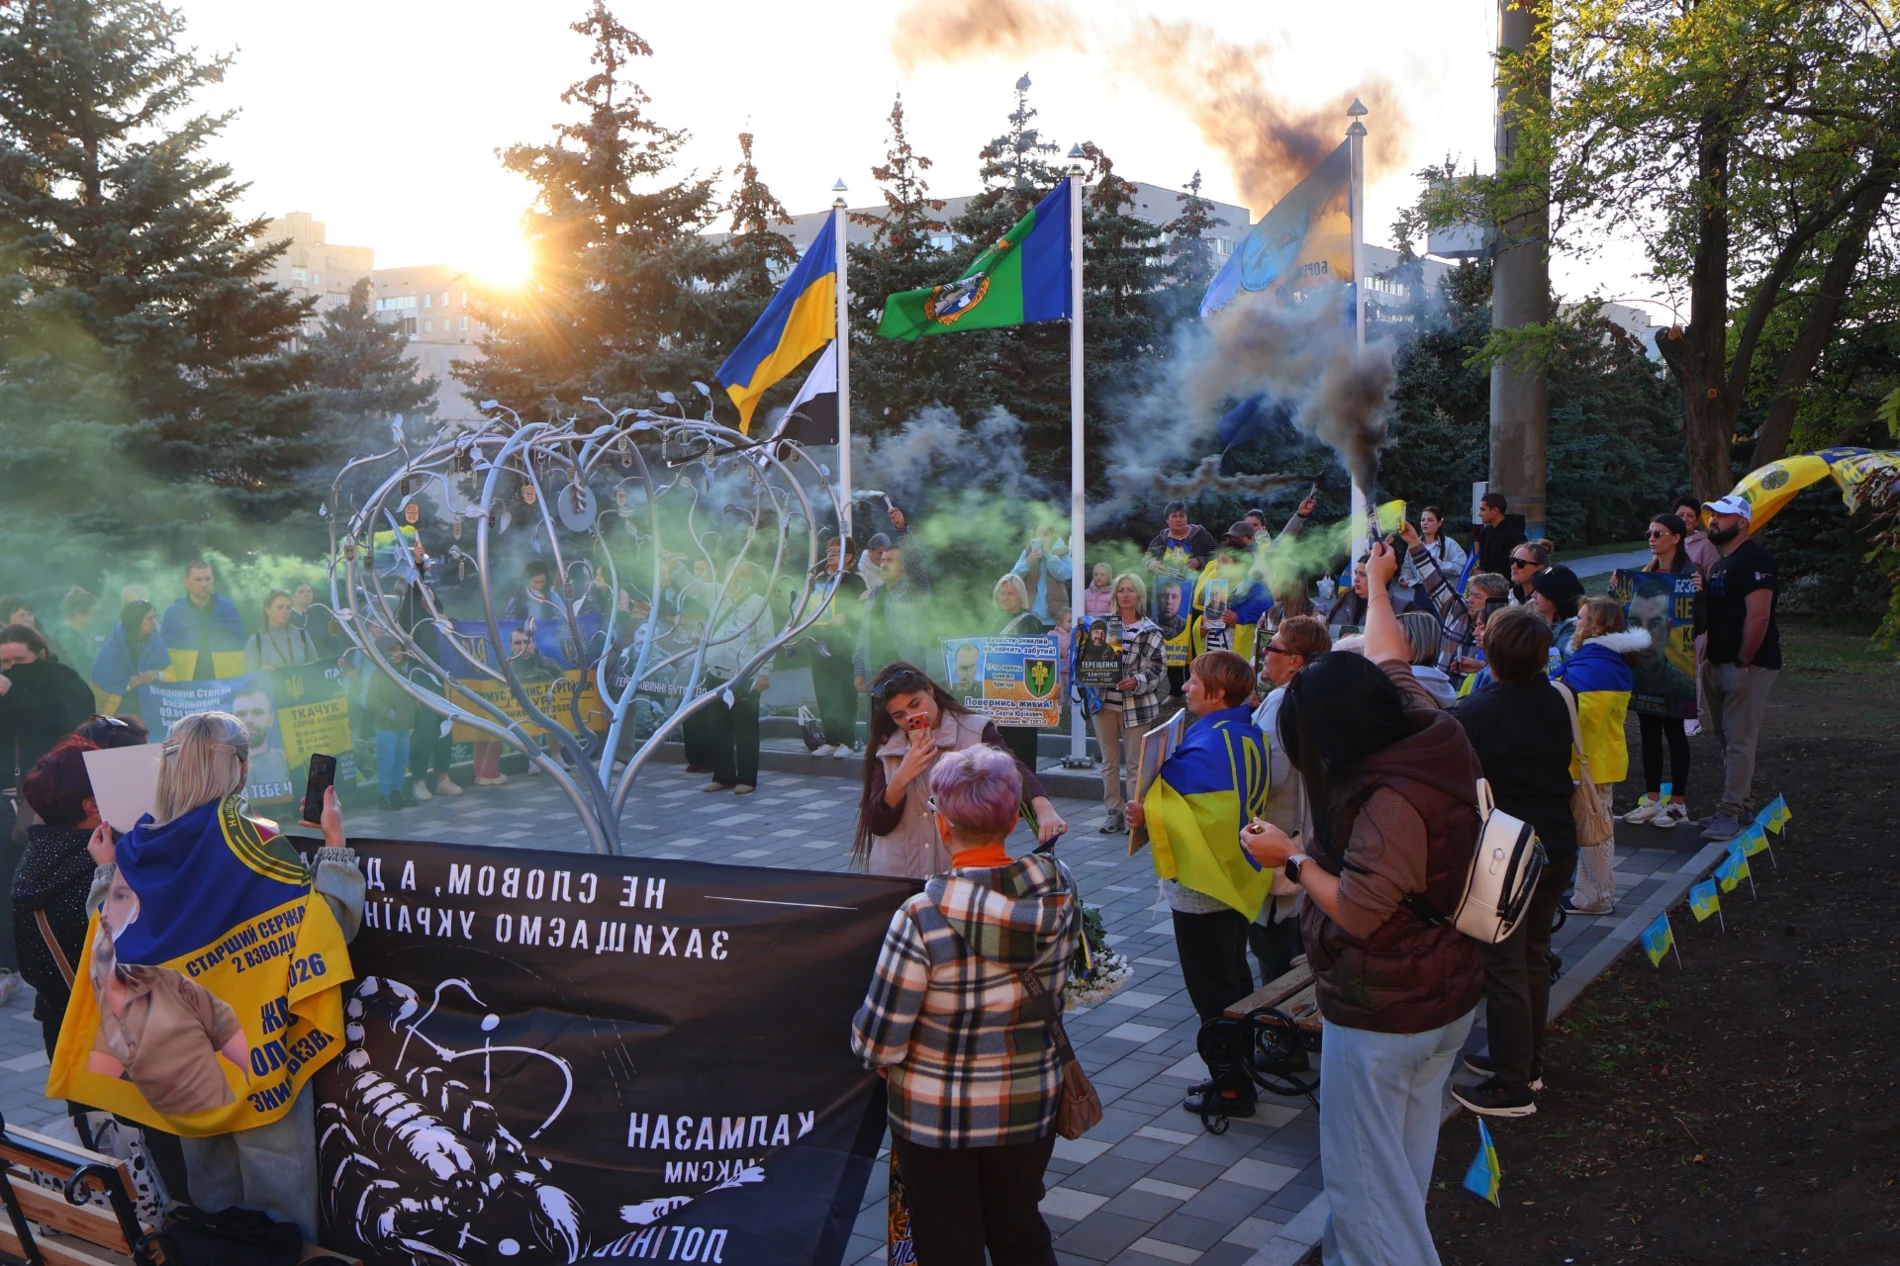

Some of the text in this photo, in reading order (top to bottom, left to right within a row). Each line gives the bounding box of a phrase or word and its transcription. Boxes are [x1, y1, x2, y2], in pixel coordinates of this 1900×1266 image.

[1675, 597, 1694, 619] НЕ
[1017, 637, 1048, 646] зниклий
[994, 646, 1022, 654] значить
[1023, 646, 1056, 657] забутий!
[1081, 661, 1118, 669] ТЕРЕЩЕНКО
[197, 686, 232, 698] Степан
[638, 680, 667, 693] ОВИННІ
[162, 697, 220, 709] Васильович
[965, 697, 1053, 708] Повернись живий!
[291, 702, 339, 720] ТКАЧУК
[250, 783, 281, 799] ТЕБЕ
[185, 924, 259, 978] СТАРШИЙ
[231, 956, 246, 974] 2
[1023, 971, 1043, 996] JIELS
